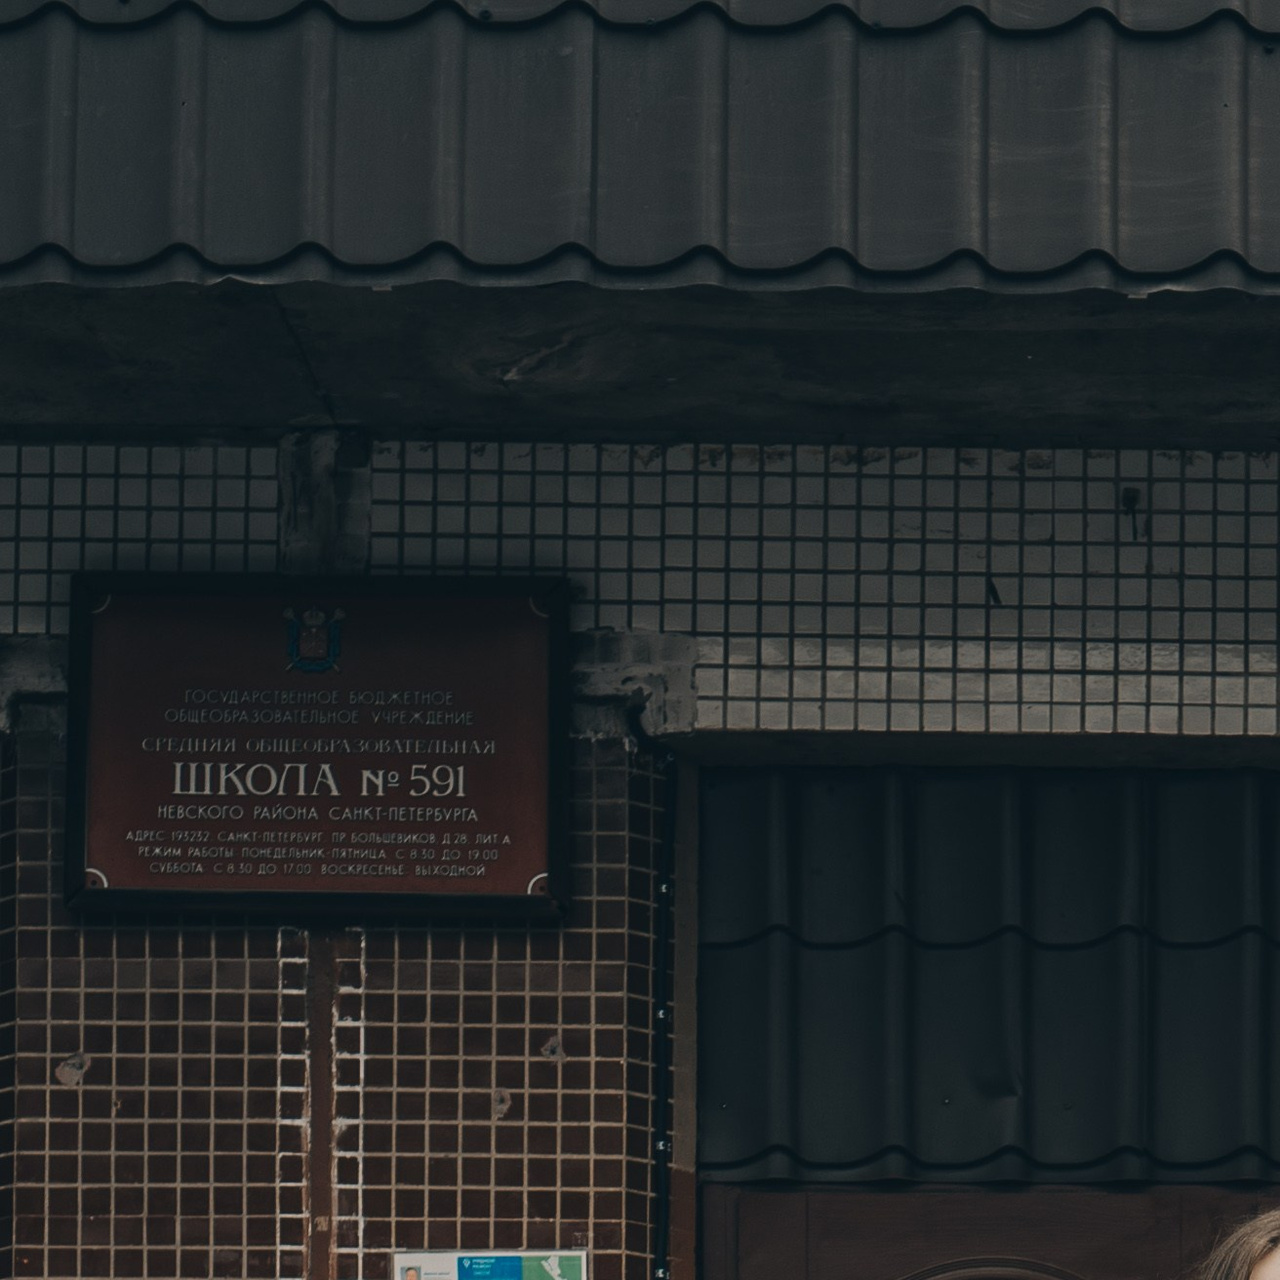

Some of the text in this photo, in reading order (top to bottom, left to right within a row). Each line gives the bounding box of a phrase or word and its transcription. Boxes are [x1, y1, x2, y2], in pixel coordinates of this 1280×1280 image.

[184, 689, 454, 706] ГОСУДАРСТВЕННОЕ БЮДЖЕТНОЕ
[164, 708, 475, 725] ОБЩЕОБРАЗОВАТЕЛЬНОЕ УЧРЕЖДЕНИЕ
[141, 737, 496, 755] СРЕДНЯЯ ОБЩЕОБРАЗОВАТЕЛЬНАЯ
[171, 761, 466, 797] ШКОЛА № 591
[157, 803, 479, 822] НЕВСКОГО РАЙОНА САНКТ-ПЕТЕРБУРГА
[138, 845, 182, 857] РЕЖИМ
[395, 848, 405, 860] С
[441, 849, 461, 861] ДО
[149, 861, 203, 873] СУББОТА
[213, 862, 223, 874] С
[257, 863, 277, 875] ДО
[415, 863, 486, 877] ВЫХОДНОЙ
